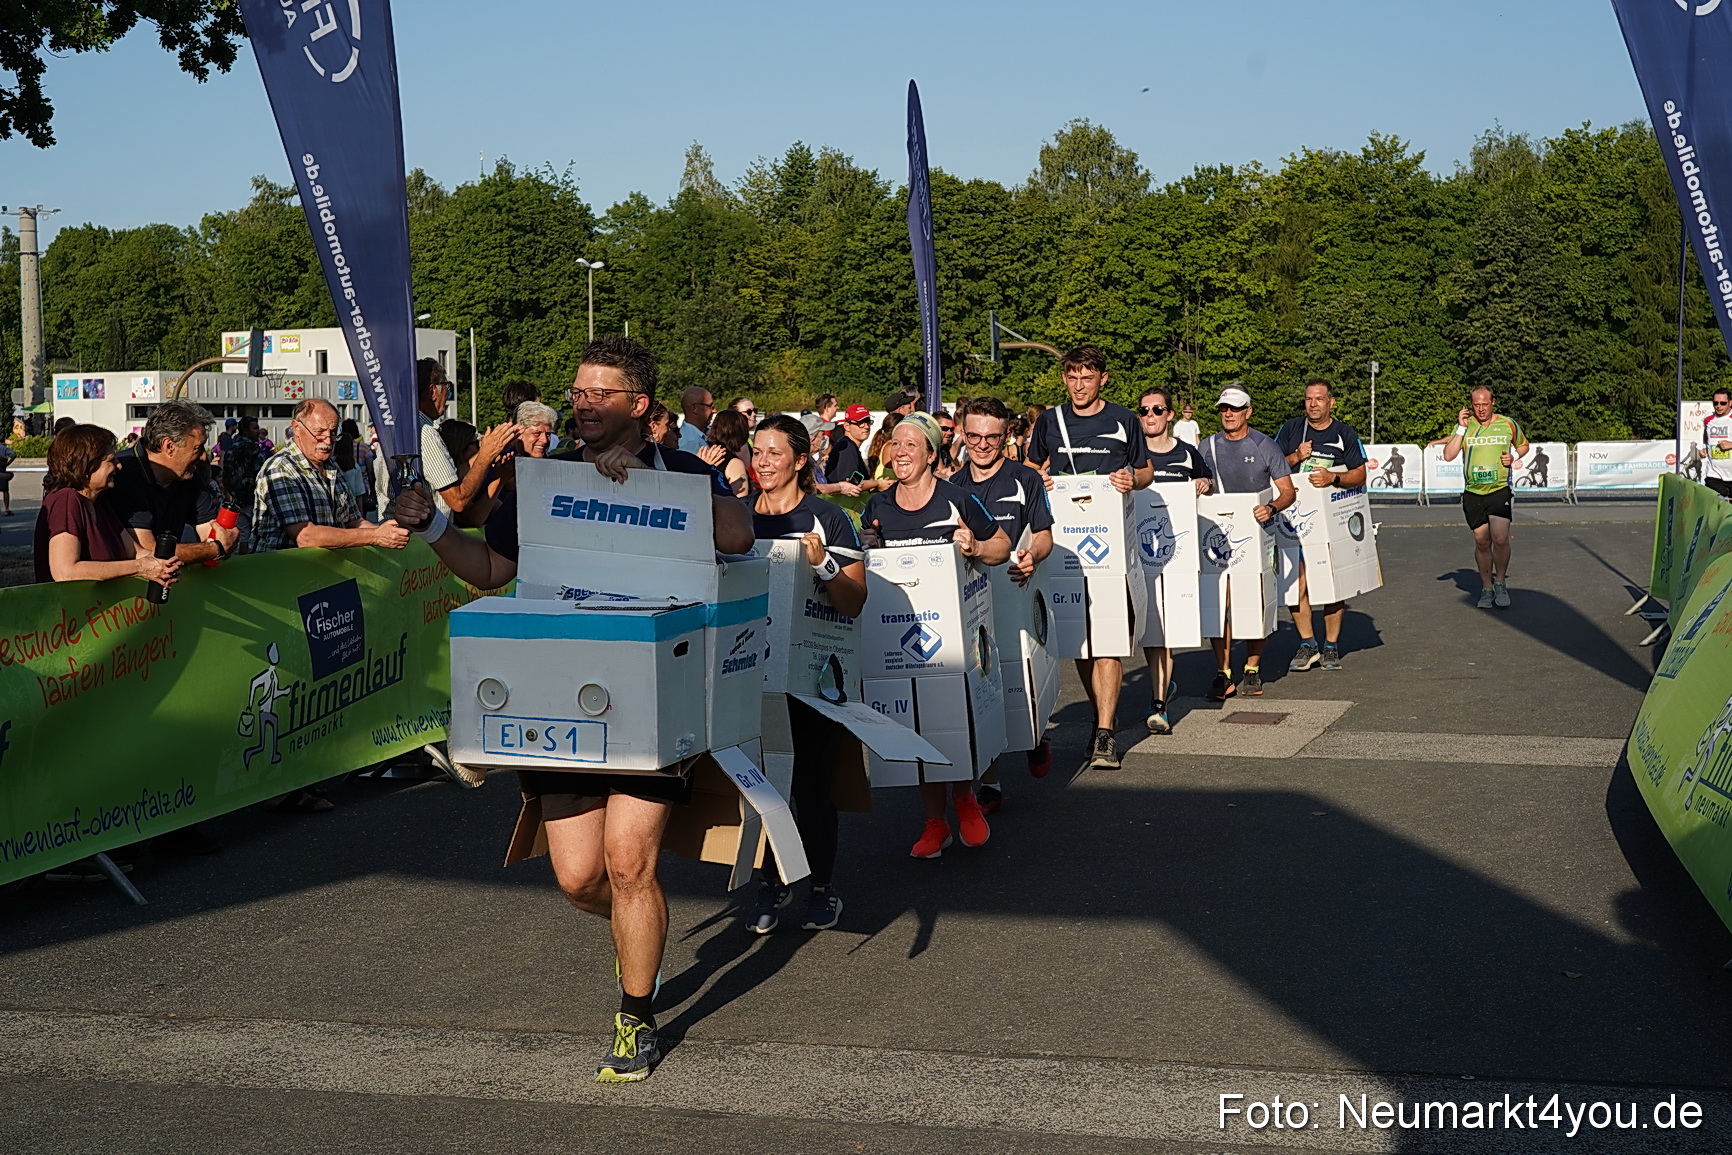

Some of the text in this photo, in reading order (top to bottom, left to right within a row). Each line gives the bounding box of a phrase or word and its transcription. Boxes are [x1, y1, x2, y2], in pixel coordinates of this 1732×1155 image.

[1466, 435, 1507, 446] BOCK
[1589, 452, 1608, 460] NOW
[551, 494, 688, 531] Schmidt
[1063, 525, 1109, 534] transratio
[1053, 592, 1082, 604] Gr. IV
[315, 609, 355, 634] Fischer
[881, 610, 940, 624] transratio
[0, 608, 82, 671] esunde
[322, 623, 354, 642] AUTOMOBILE
[111, 620, 177, 681] länger!
[722, 653, 757, 675] Schmidt
[36, 656, 104, 709] laufen
[289, 632, 408, 732] firmenlauf
[872, 700, 908, 714] Gr. IV
[289, 713, 344, 753] neumarkt
[736, 768, 764, 788] Gr. IV
[0, 777, 196, 863] rmenlauf-oberpfalz.de
[1694, 794, 1731, 829] neumarkt
